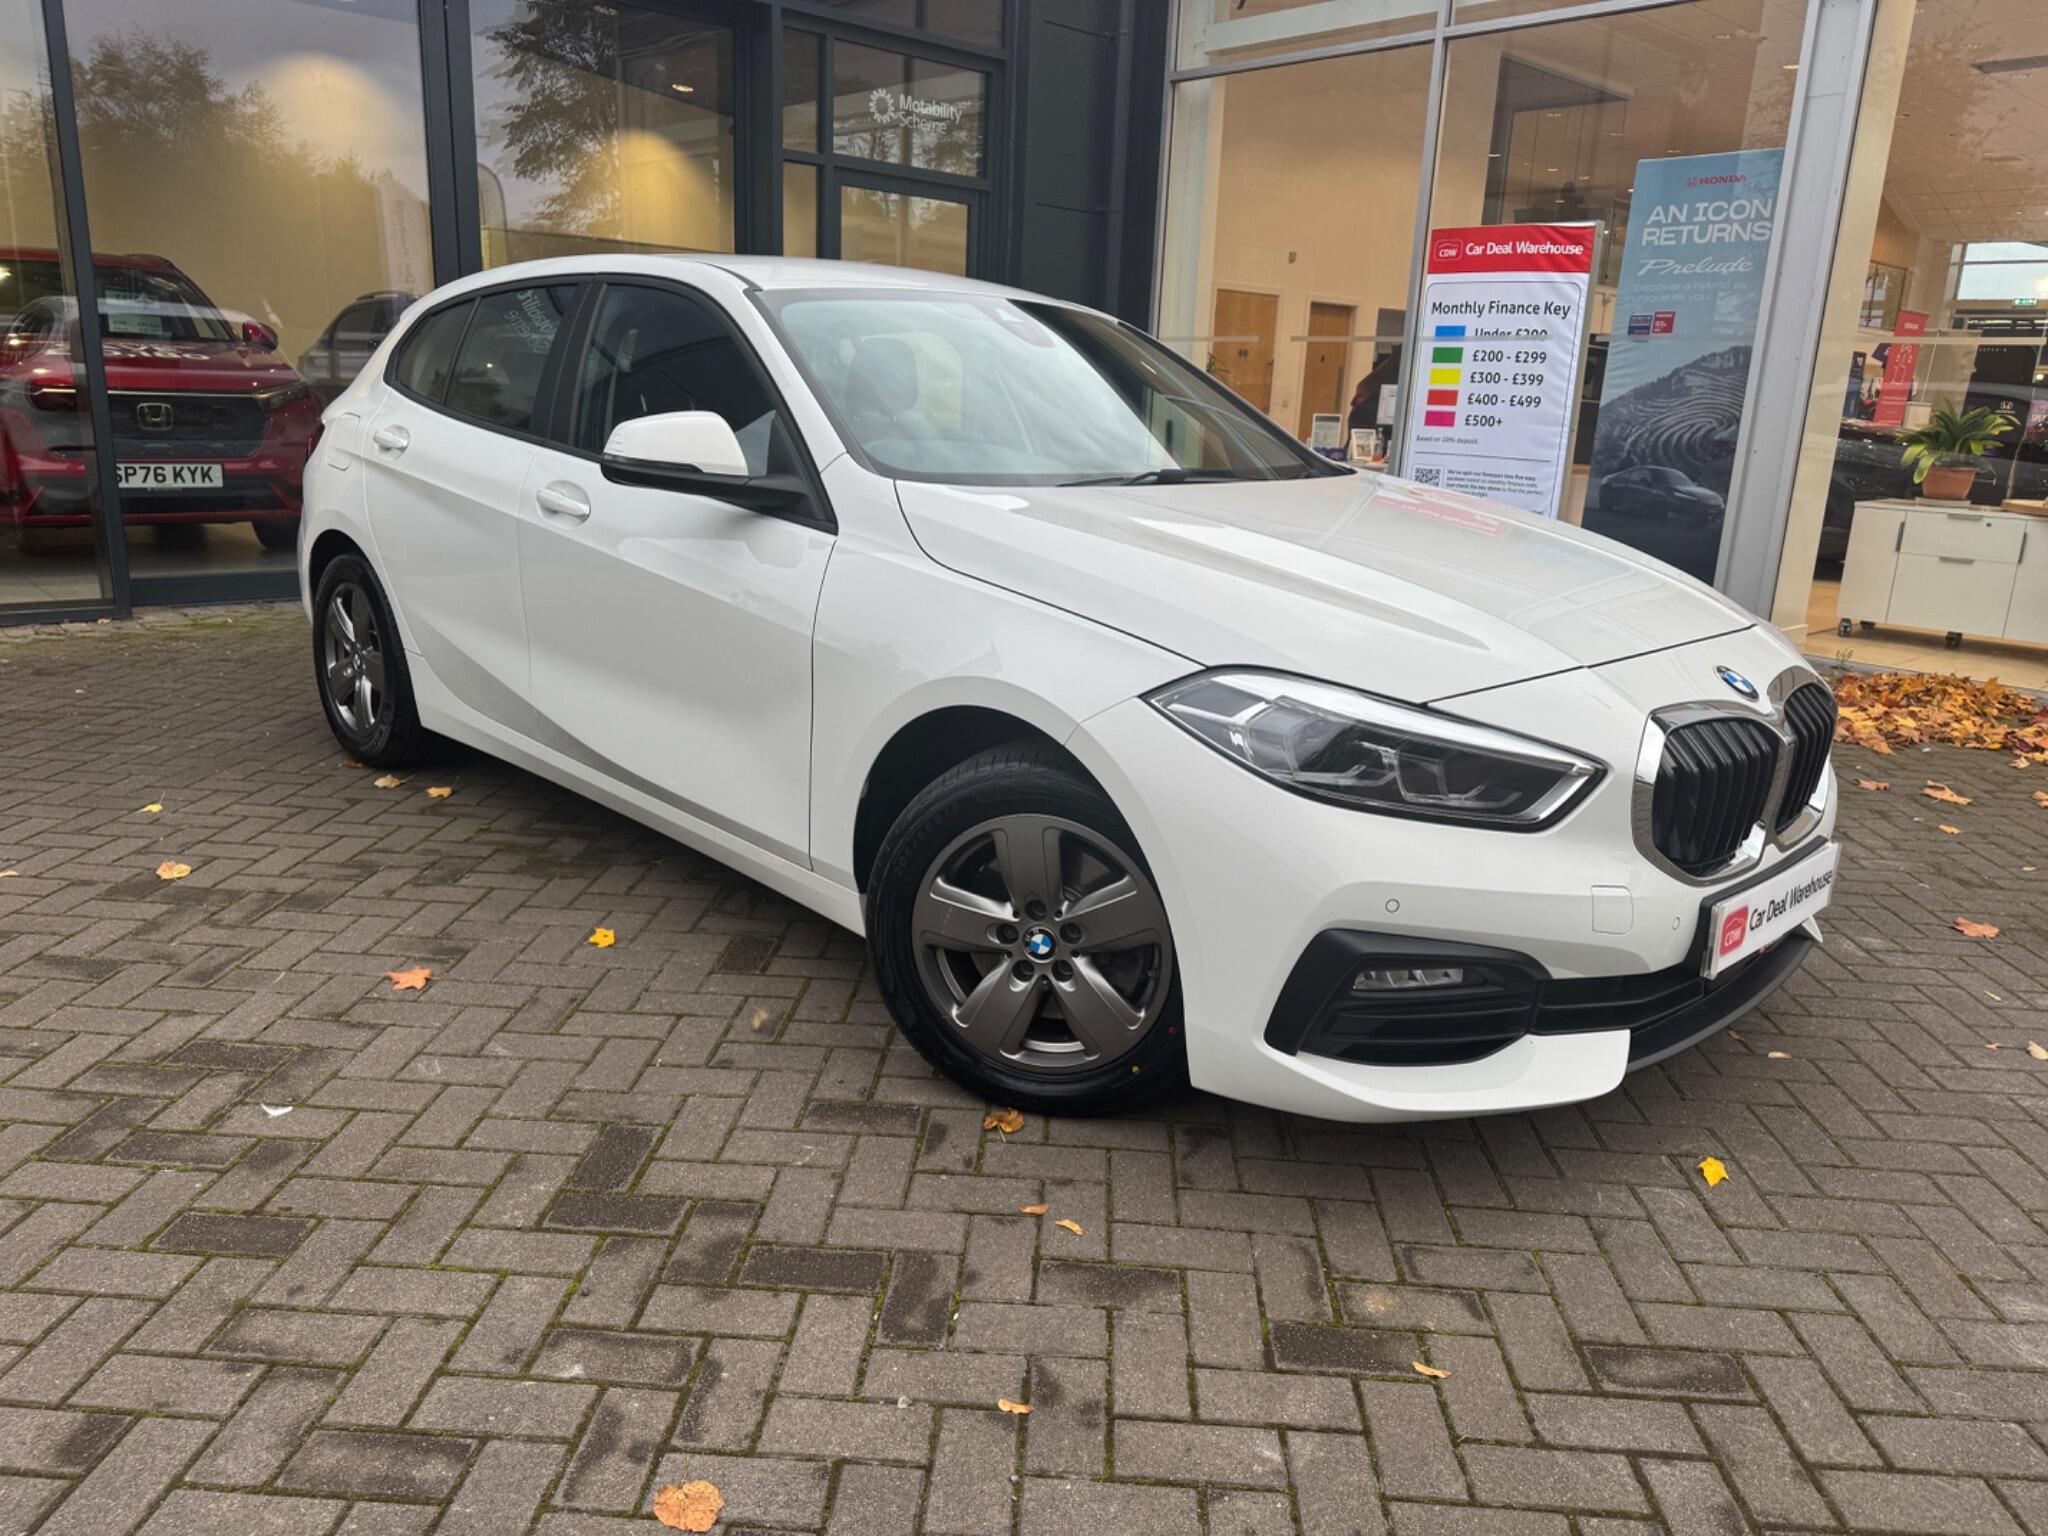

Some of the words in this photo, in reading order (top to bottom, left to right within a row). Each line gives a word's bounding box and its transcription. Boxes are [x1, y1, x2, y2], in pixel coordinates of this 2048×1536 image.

[900, 93, 962, 124] Motability
[899, 111, 947, 134] Scheme
[1699, 174, 1747, 185] HONDA
[1646, 203, 1688, 225] AN
[1693, 198, 1773, 222] ICON
[1641, 221, 1772, 247] RETURNS
[1439, 250, 1458, 258] CDW
[1465, 242, 1485, 255] Car
[1486, 241, 1512, 255] Deal
[1516, 240, 1584, 255] Warehouse
[1637, 256, 1753, 276] Prelude
[1431, 301, 1486, 318] Monthly
[1488, 301, 1541, 315] Finance
[1544, 302, 1571, 319] Key
[1473, 350, 1504, 362] £200
[1515, 351, 1547, 364] £299
[1470, 371, 1501, 384] £300
[1512, 373, 1544, 386] £399
[1468, 393, 1499, 406] £400
[1509, 395, 1541, 408] £499
[1464, 414, 1503, 427] £500+
[173, 466, 214, 484] KYK
[1749, 908, 1767, 931] Car
[1766, 890, 1789, 922] Deal
[1789, 870, 1833, 909] Warehouse
